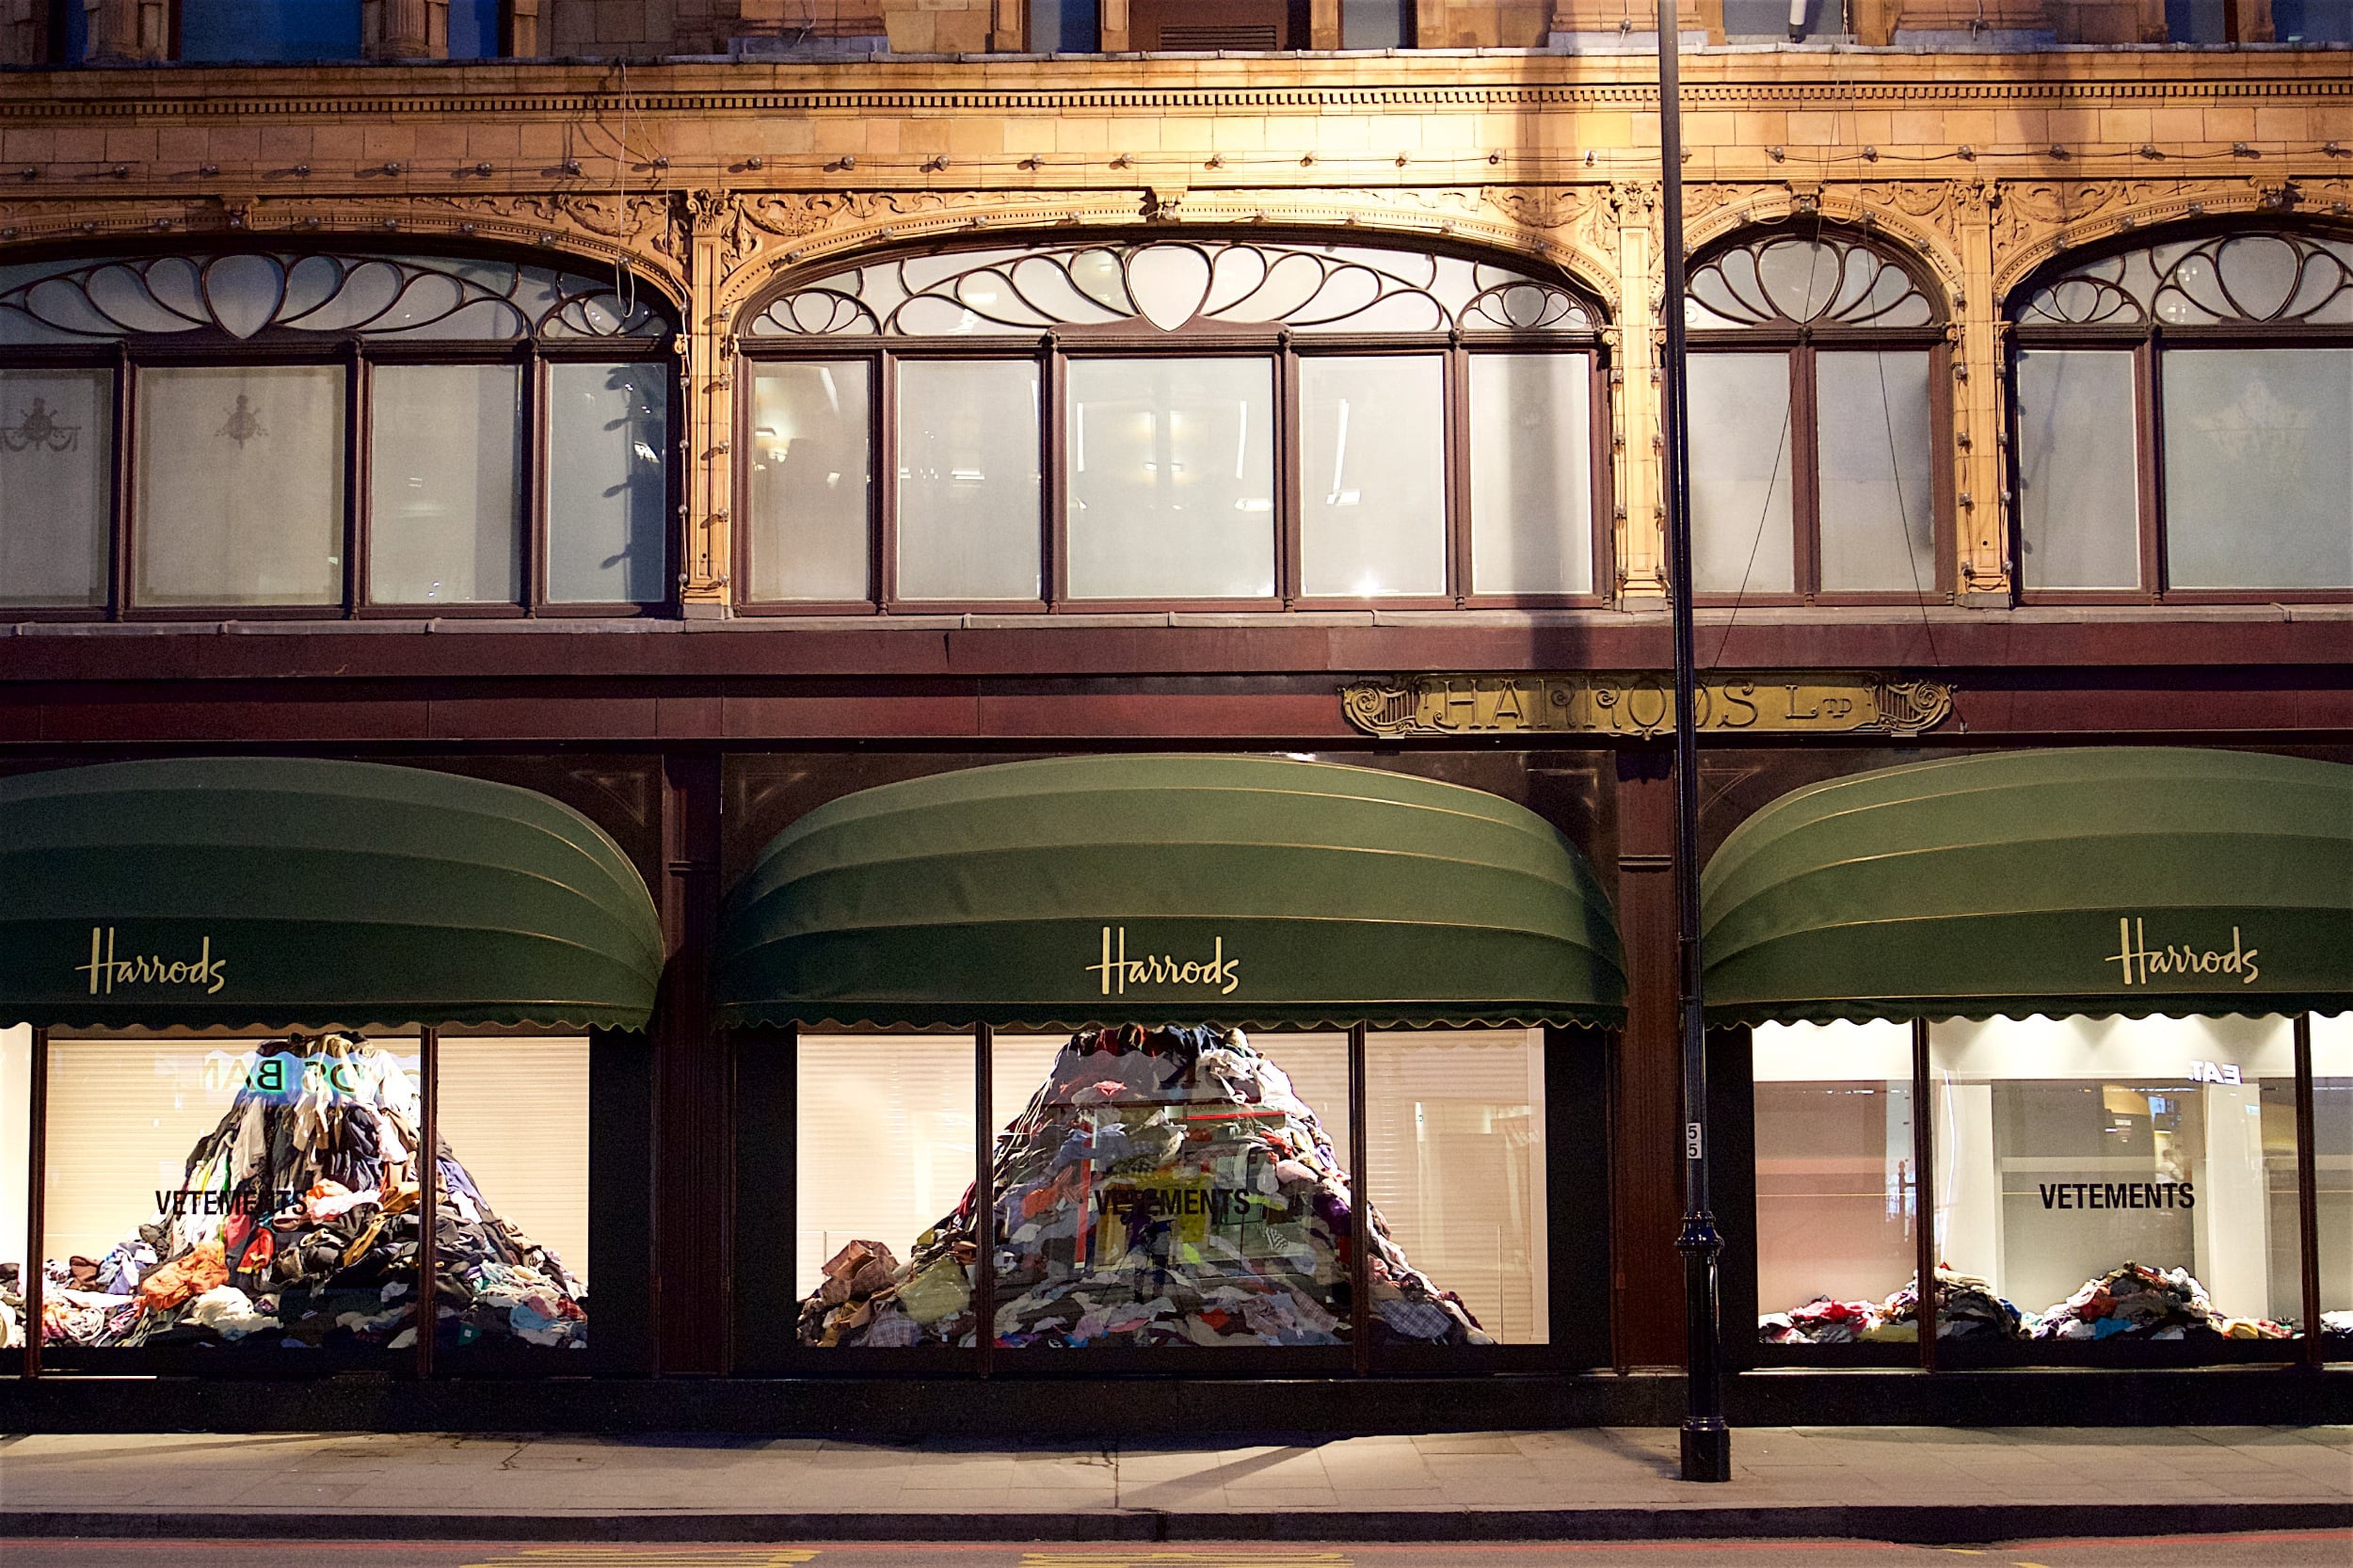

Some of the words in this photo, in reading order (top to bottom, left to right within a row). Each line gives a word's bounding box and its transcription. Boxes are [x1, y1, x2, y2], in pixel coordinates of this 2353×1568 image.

[1433, 678, 1758, 729] HARRODS
[74, 926, 227, 995] Harrods
[1085, 926, 1240, 995] Harrods
[2105, 917, 2259, 985] Harrods
[1689, 1126, 1698, 1140] 5
[1689, 1144, 1698, 1157] 5
[1095, 1189, 1251, 1216] VETEMENTS
[2039, 1182, 2195, 1209] VETEMENTS
